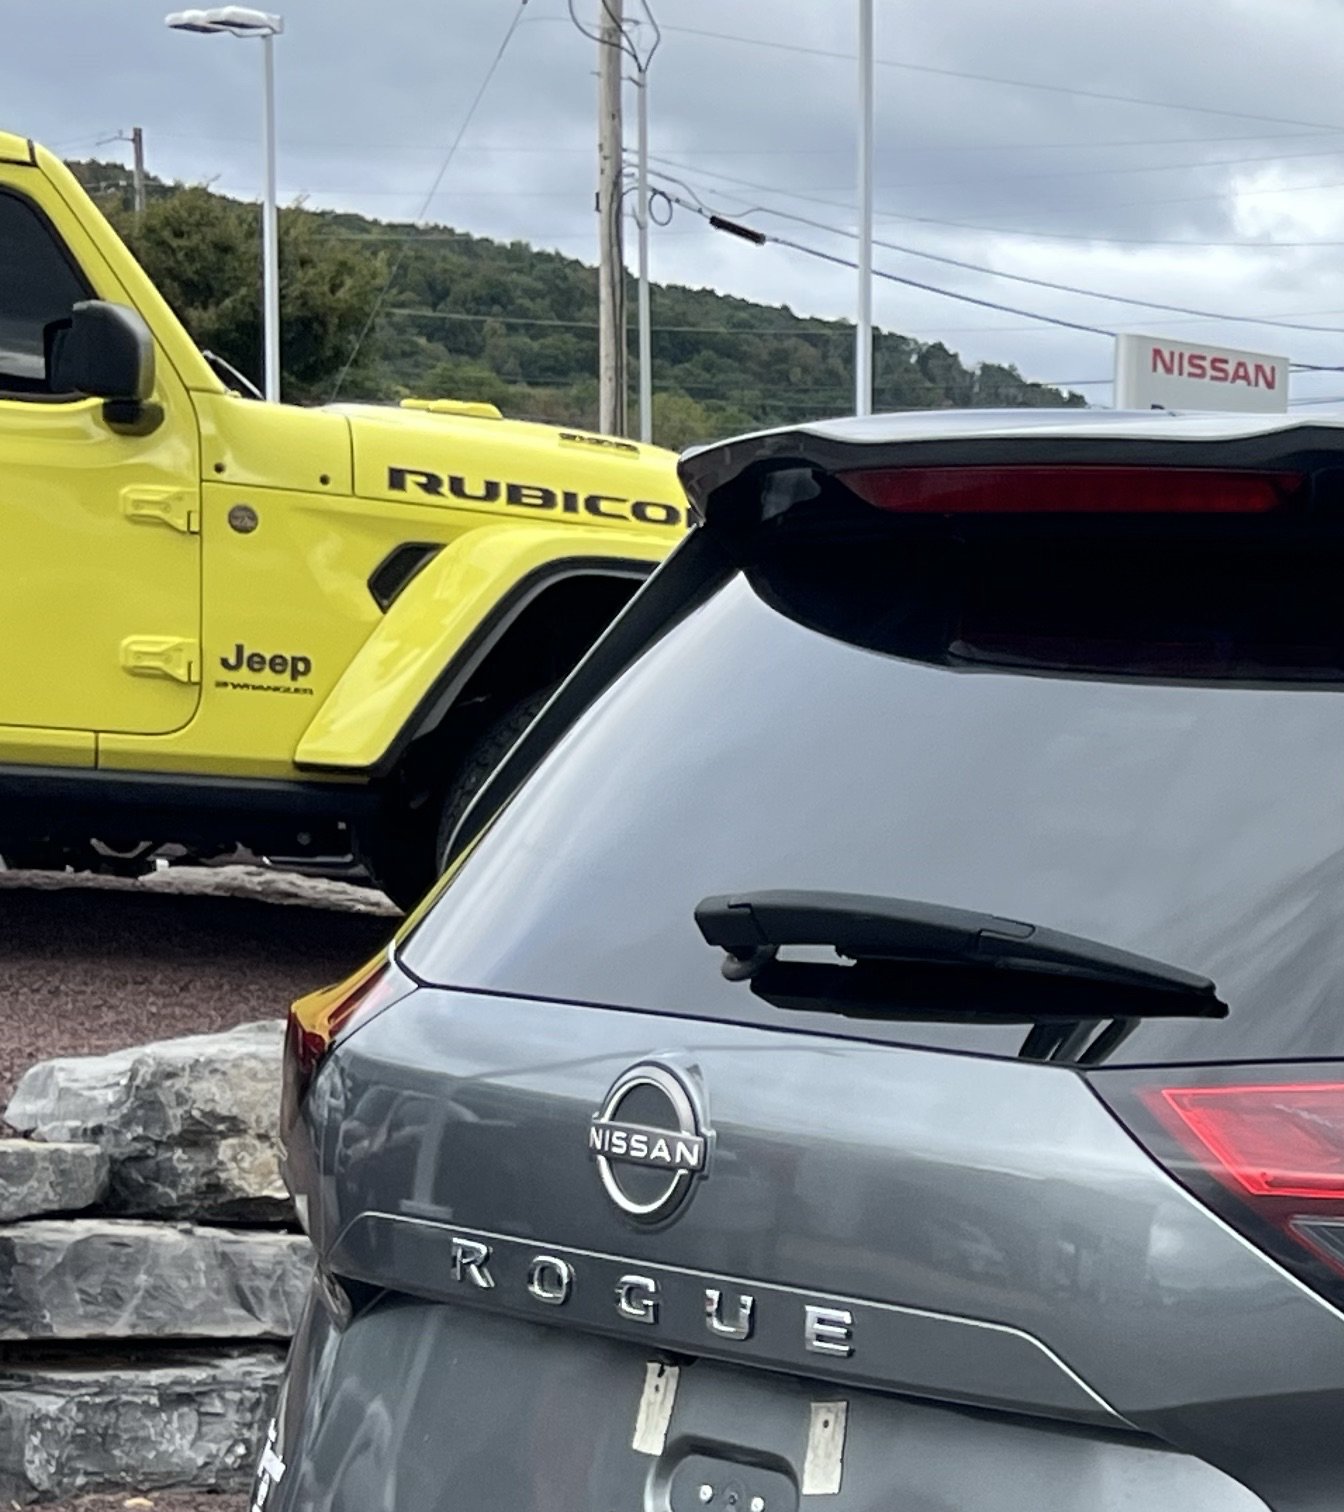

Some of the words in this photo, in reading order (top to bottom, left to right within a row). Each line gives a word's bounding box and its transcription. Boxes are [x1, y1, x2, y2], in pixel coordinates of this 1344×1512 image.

[1151, 347, 1276, 390] NISSAN
[220, 643, 312, 682] Jeep
[589, 1126, 699, 1166] NISSAN
[450, 1237, 855, 1358] ROGUE
